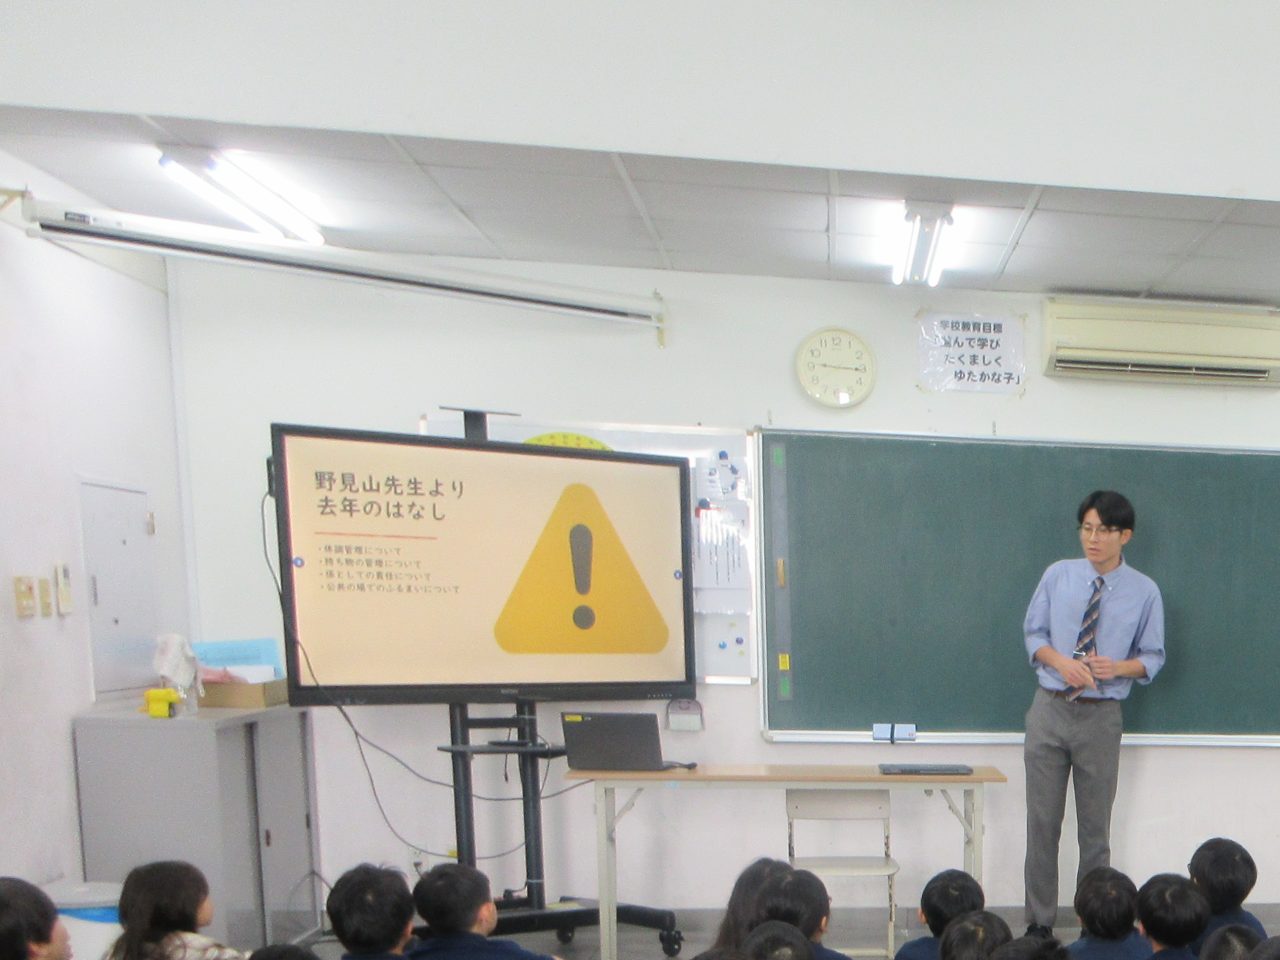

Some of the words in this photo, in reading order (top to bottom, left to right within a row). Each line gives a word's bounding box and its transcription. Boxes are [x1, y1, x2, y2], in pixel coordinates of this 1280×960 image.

[832, 336, 841, 346] 12
[315, 471, 464, 499] 野見山先生より
[317, 496, 446, 521] 去年のはなし
